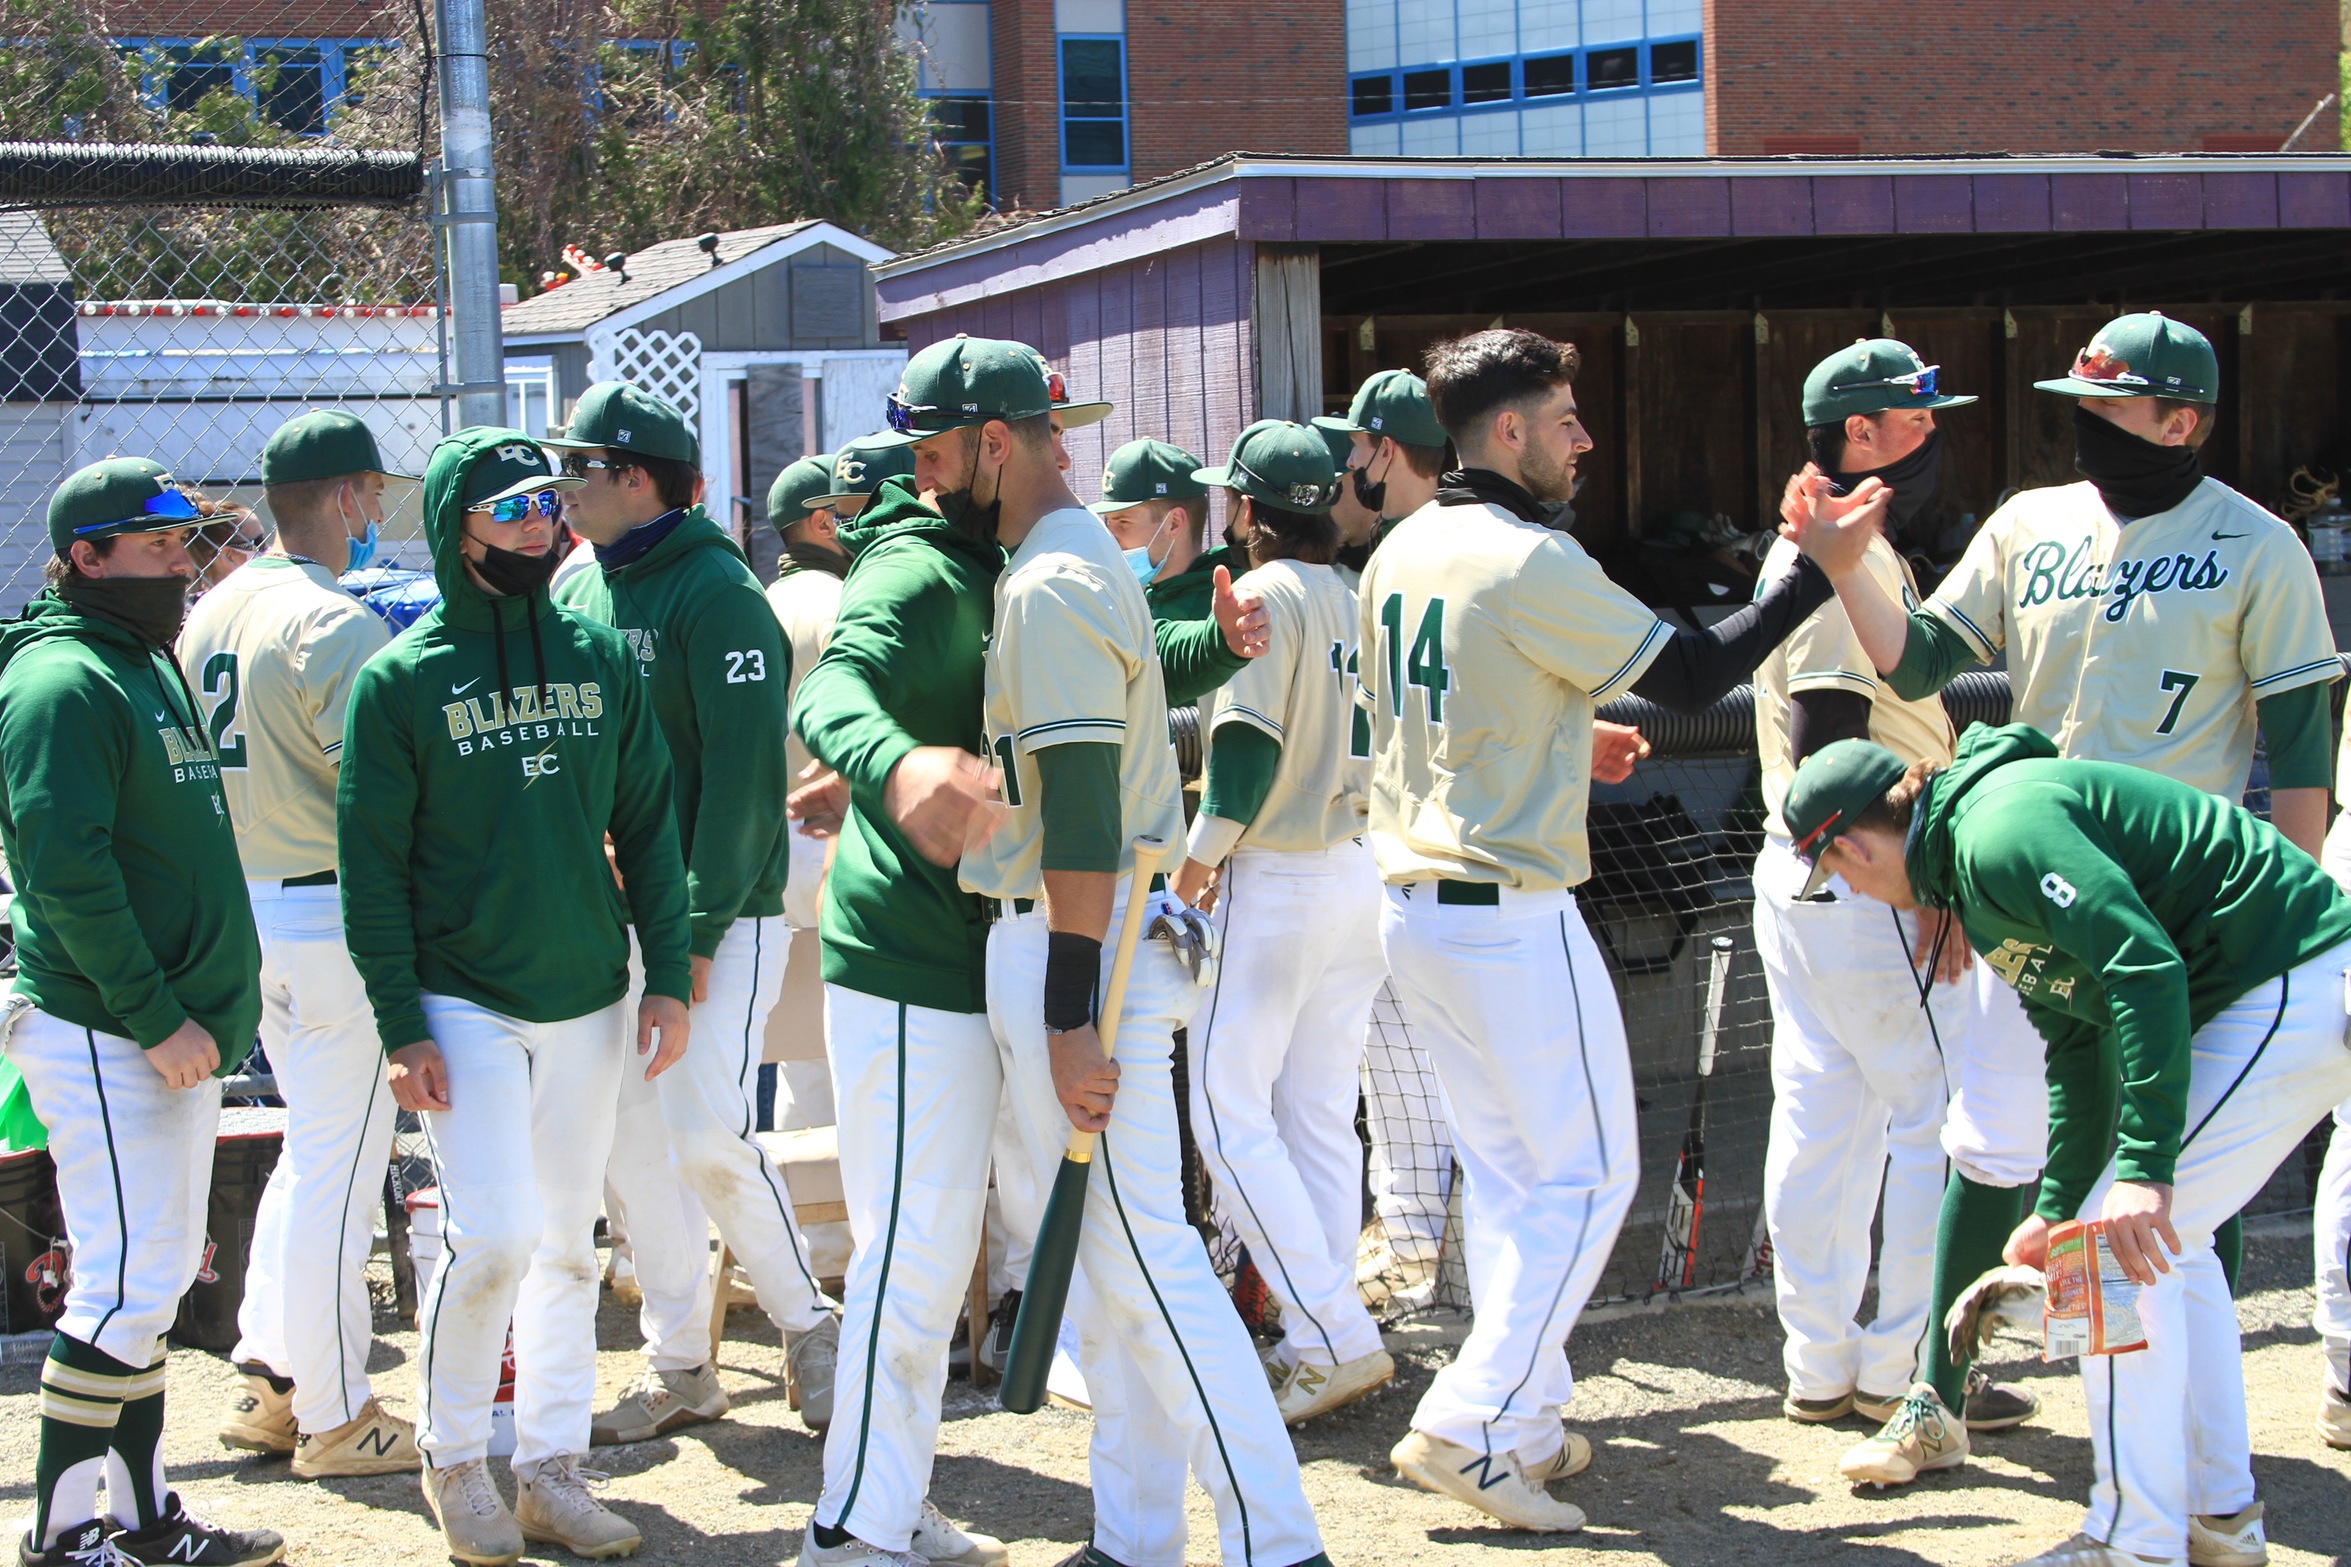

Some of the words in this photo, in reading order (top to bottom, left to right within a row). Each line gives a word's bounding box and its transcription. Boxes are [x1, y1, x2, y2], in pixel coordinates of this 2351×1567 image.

[836, 452, 867, 484] EC
[2019, 535, 2229, 622] Blazers
[724, 649, 766, 684] 23
[1380, 589, 1451, 729] 14
[442, 682, 603, 740] BLAZERS
[2153, 668, 2202, 736] 7
[458, 722, 599, 757] BASEBALL
[522, 753, 560, 777] EC
[2040, 872, 2077, 908] 8
[389, 1164, 405, 1204] HICKORY
[1296, 1366, 1327, 1396] N
[356, 1427, 399, 1456] N
[1459, 1455, 1510, 1491] N
[167, 1533, 210, 1563] N
